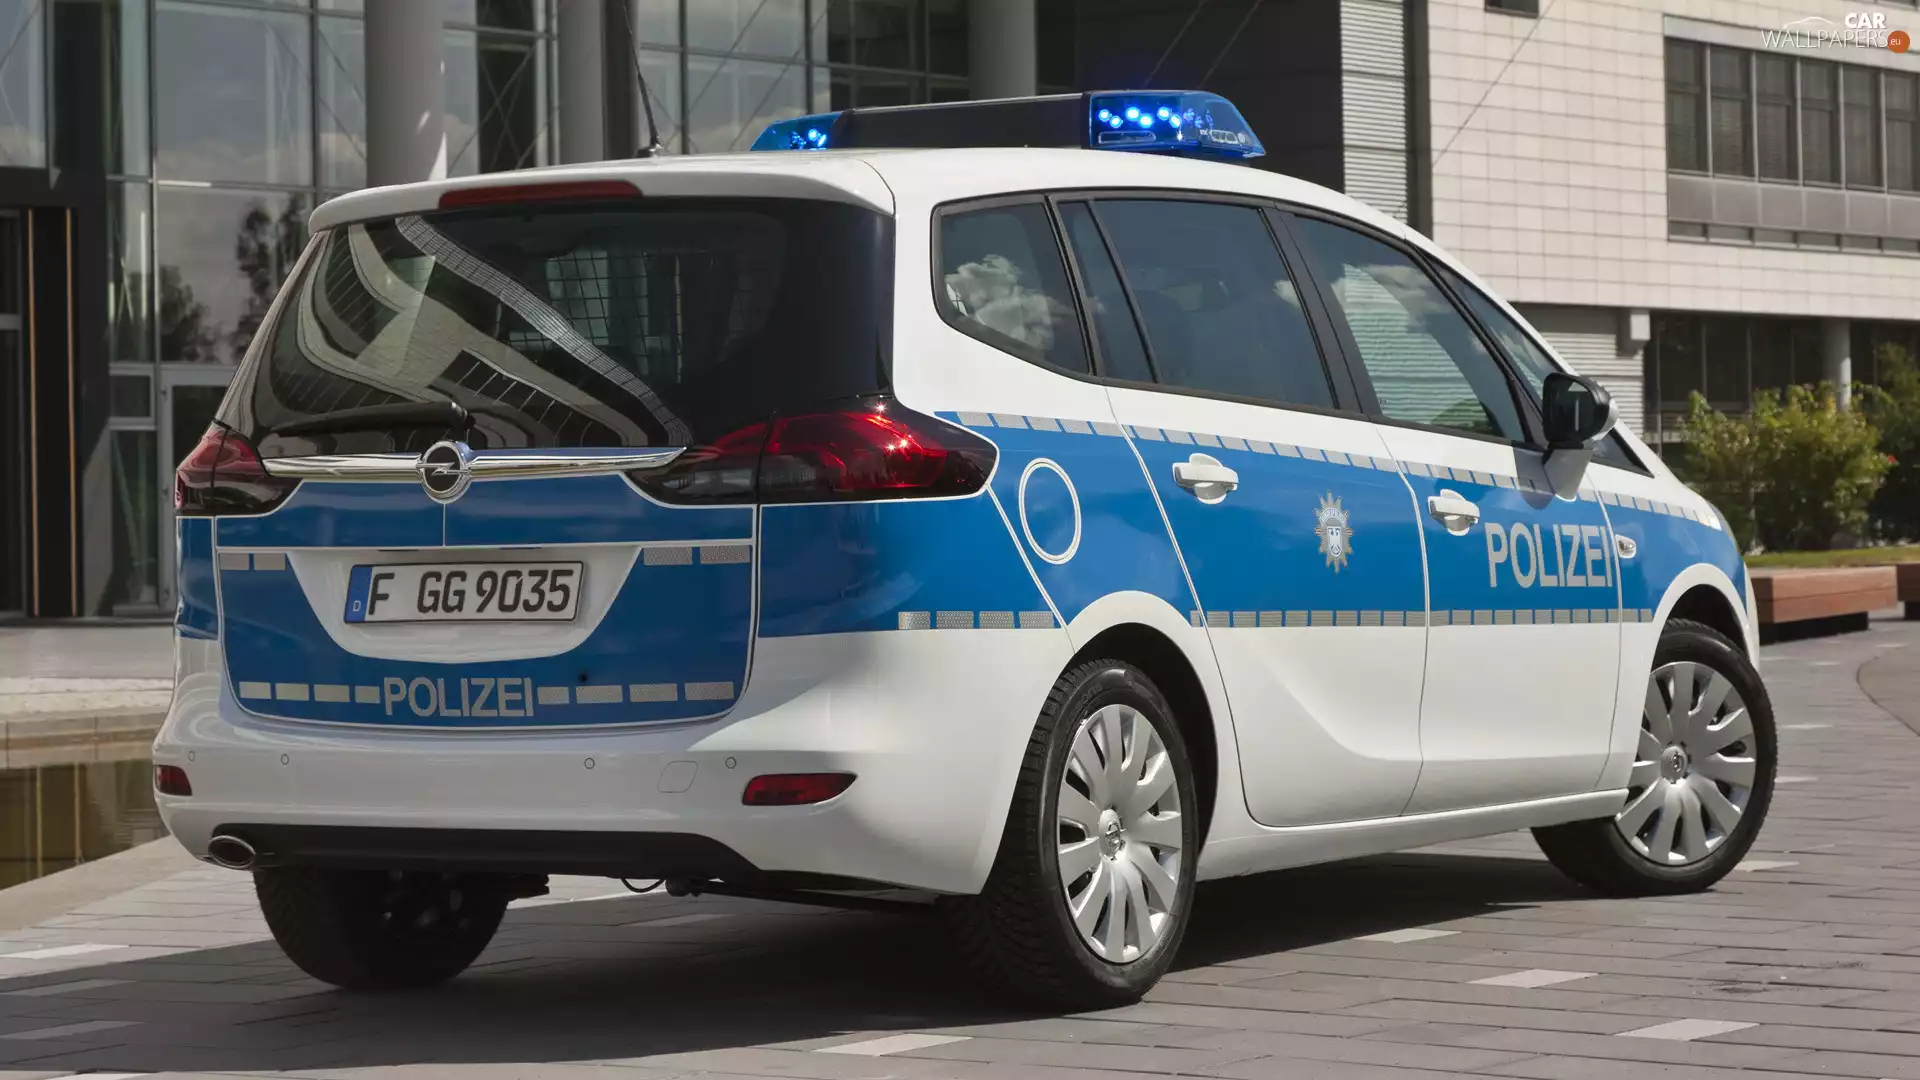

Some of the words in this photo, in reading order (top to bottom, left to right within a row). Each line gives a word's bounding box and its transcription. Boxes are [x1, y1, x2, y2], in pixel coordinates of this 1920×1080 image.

[1484, 522, 1613, 588] POLIZEI
[352, 600, 361, 612] D
[368, 572, 395, 615] F
[417, 570, 467, 614] GG
[475, 569, 574, 613] 9035
[383, 676, 535, 717] POLIZEI
